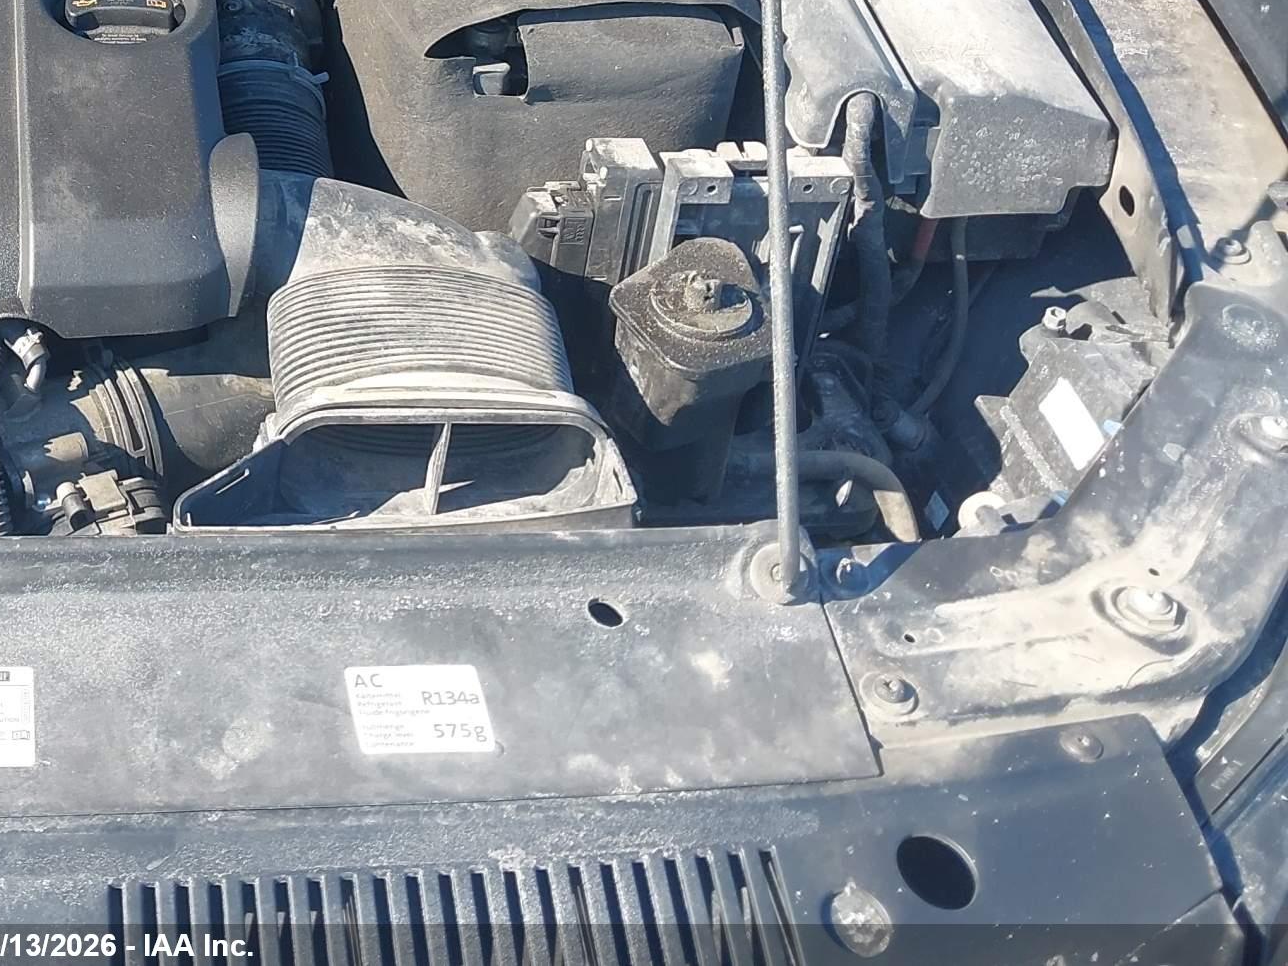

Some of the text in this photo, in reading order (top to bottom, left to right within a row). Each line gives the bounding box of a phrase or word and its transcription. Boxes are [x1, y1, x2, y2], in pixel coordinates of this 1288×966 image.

[354, 673, 384, 688] AC
[421, 690, 481, 706] R134a
[433, 723, 489, 743] 575g
